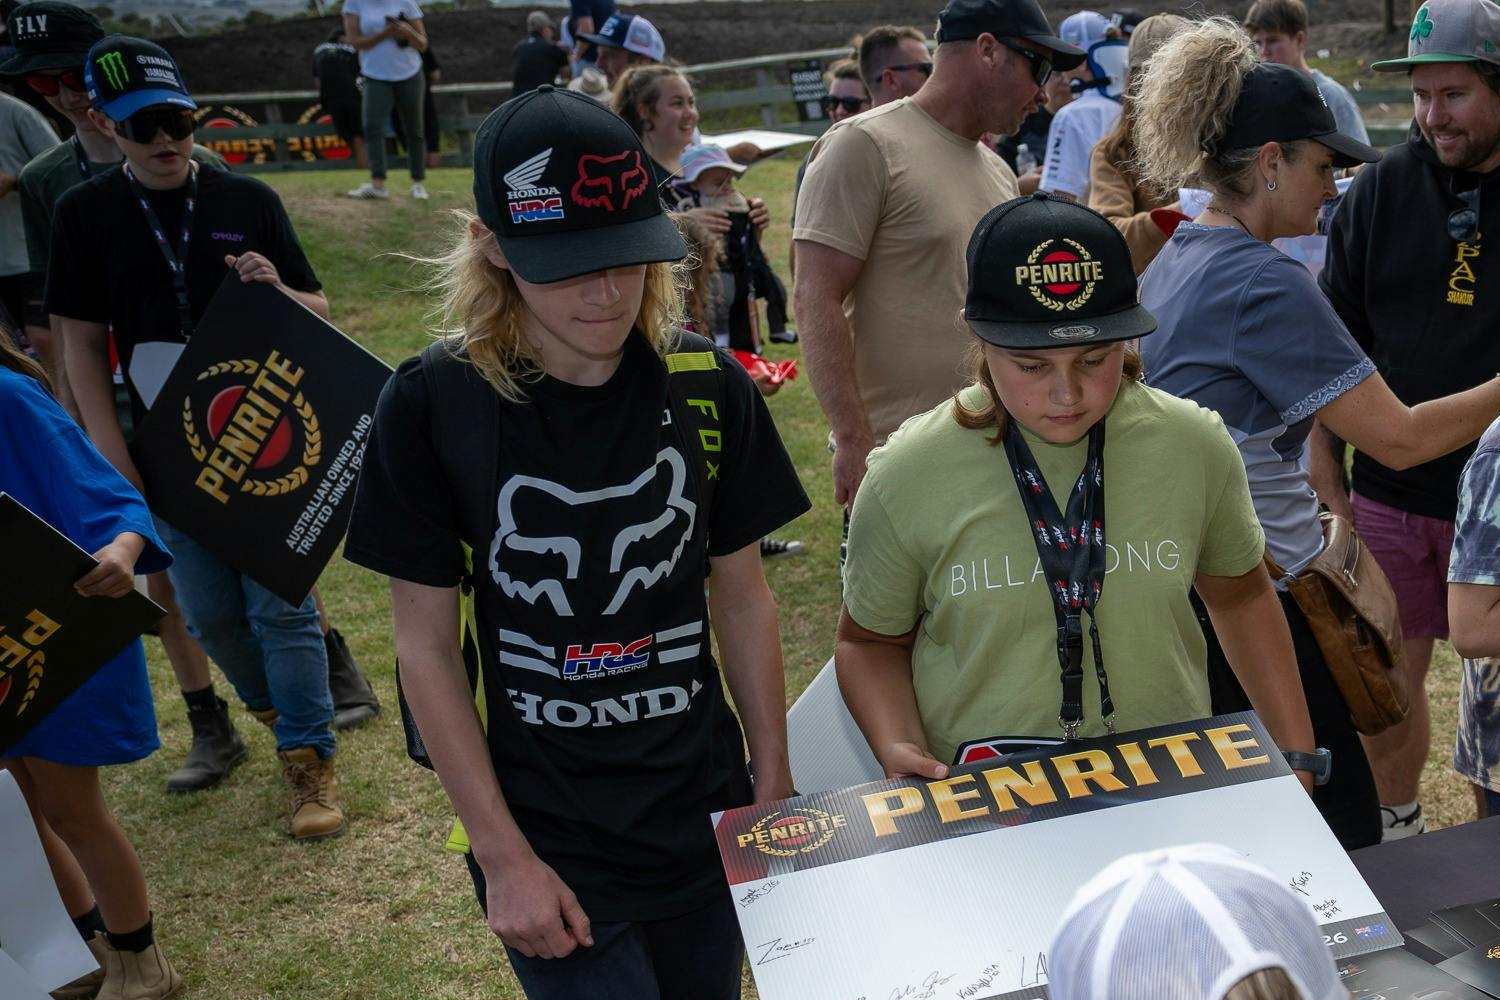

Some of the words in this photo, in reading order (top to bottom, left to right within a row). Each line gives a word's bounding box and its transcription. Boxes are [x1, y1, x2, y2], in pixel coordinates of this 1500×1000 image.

[16, 14, 47, 35] FLY
[506, 186, 561, 200] HONDA
[509, 197, 564, 224] HRC
[211, 232, 244, 242] OAKLEY
[1015, 261, 1104, 286] PENRITE
[195, 350, 305, 505] PENRITE
[686, 398, 722, 481] FOX
[285, 478, 334, 550] AUSTRALIAN
[327, 441, 358, 481] OWNED
[351, 413, 372, 447] AND
[296, 505, 334, 557] TRUSTED
[328, 469, 357, 507] SINCE
[562, 634, 654, 675] HRC
[564, 671, 605, 681] Honda
[607, 662, 648, 676] RACING
[506, 679, 702, 727] HOND
[859, 722, 1271, 838] PENRITE
[737, 814, 848, 848] PENRITE
